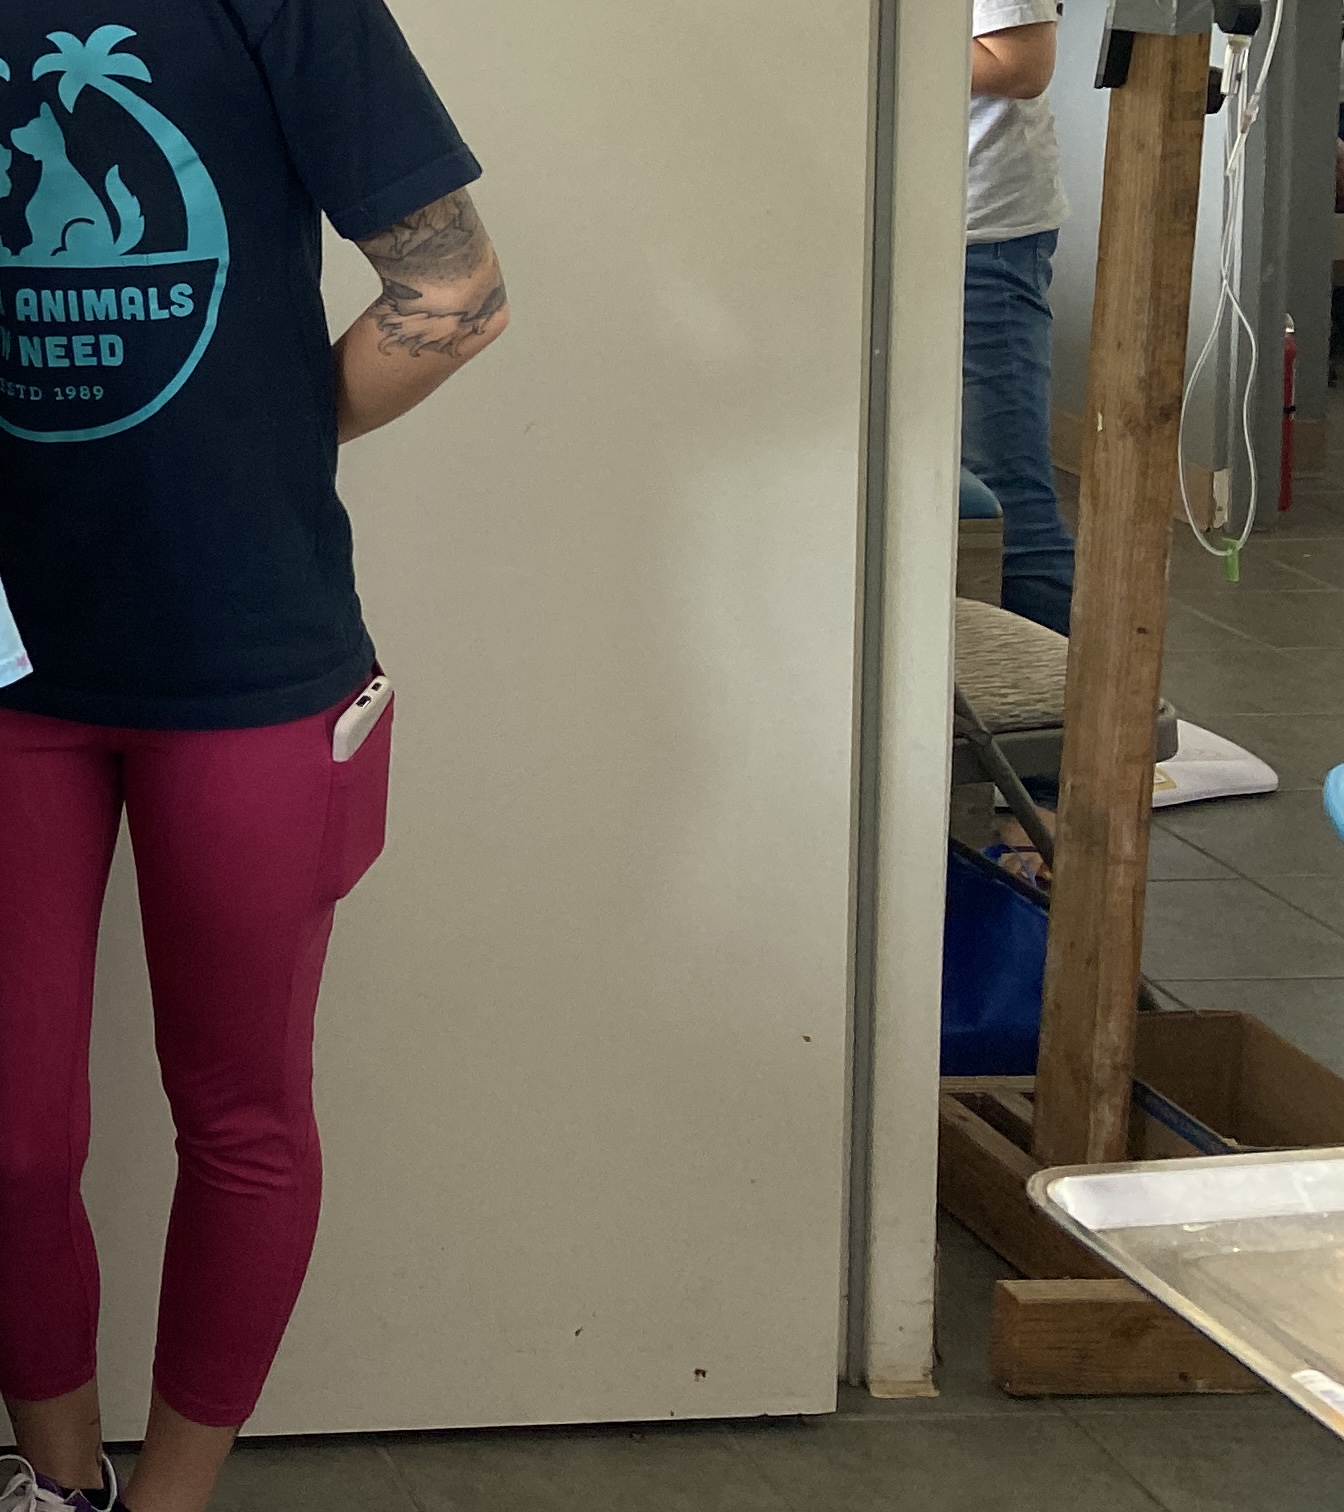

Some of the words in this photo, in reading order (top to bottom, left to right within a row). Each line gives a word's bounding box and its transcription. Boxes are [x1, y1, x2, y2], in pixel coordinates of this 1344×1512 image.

[15, 282, 195, 323] ANIMALS
[19, 334, 125, 368] NEED
[53, 385, 105, 402] 1989
